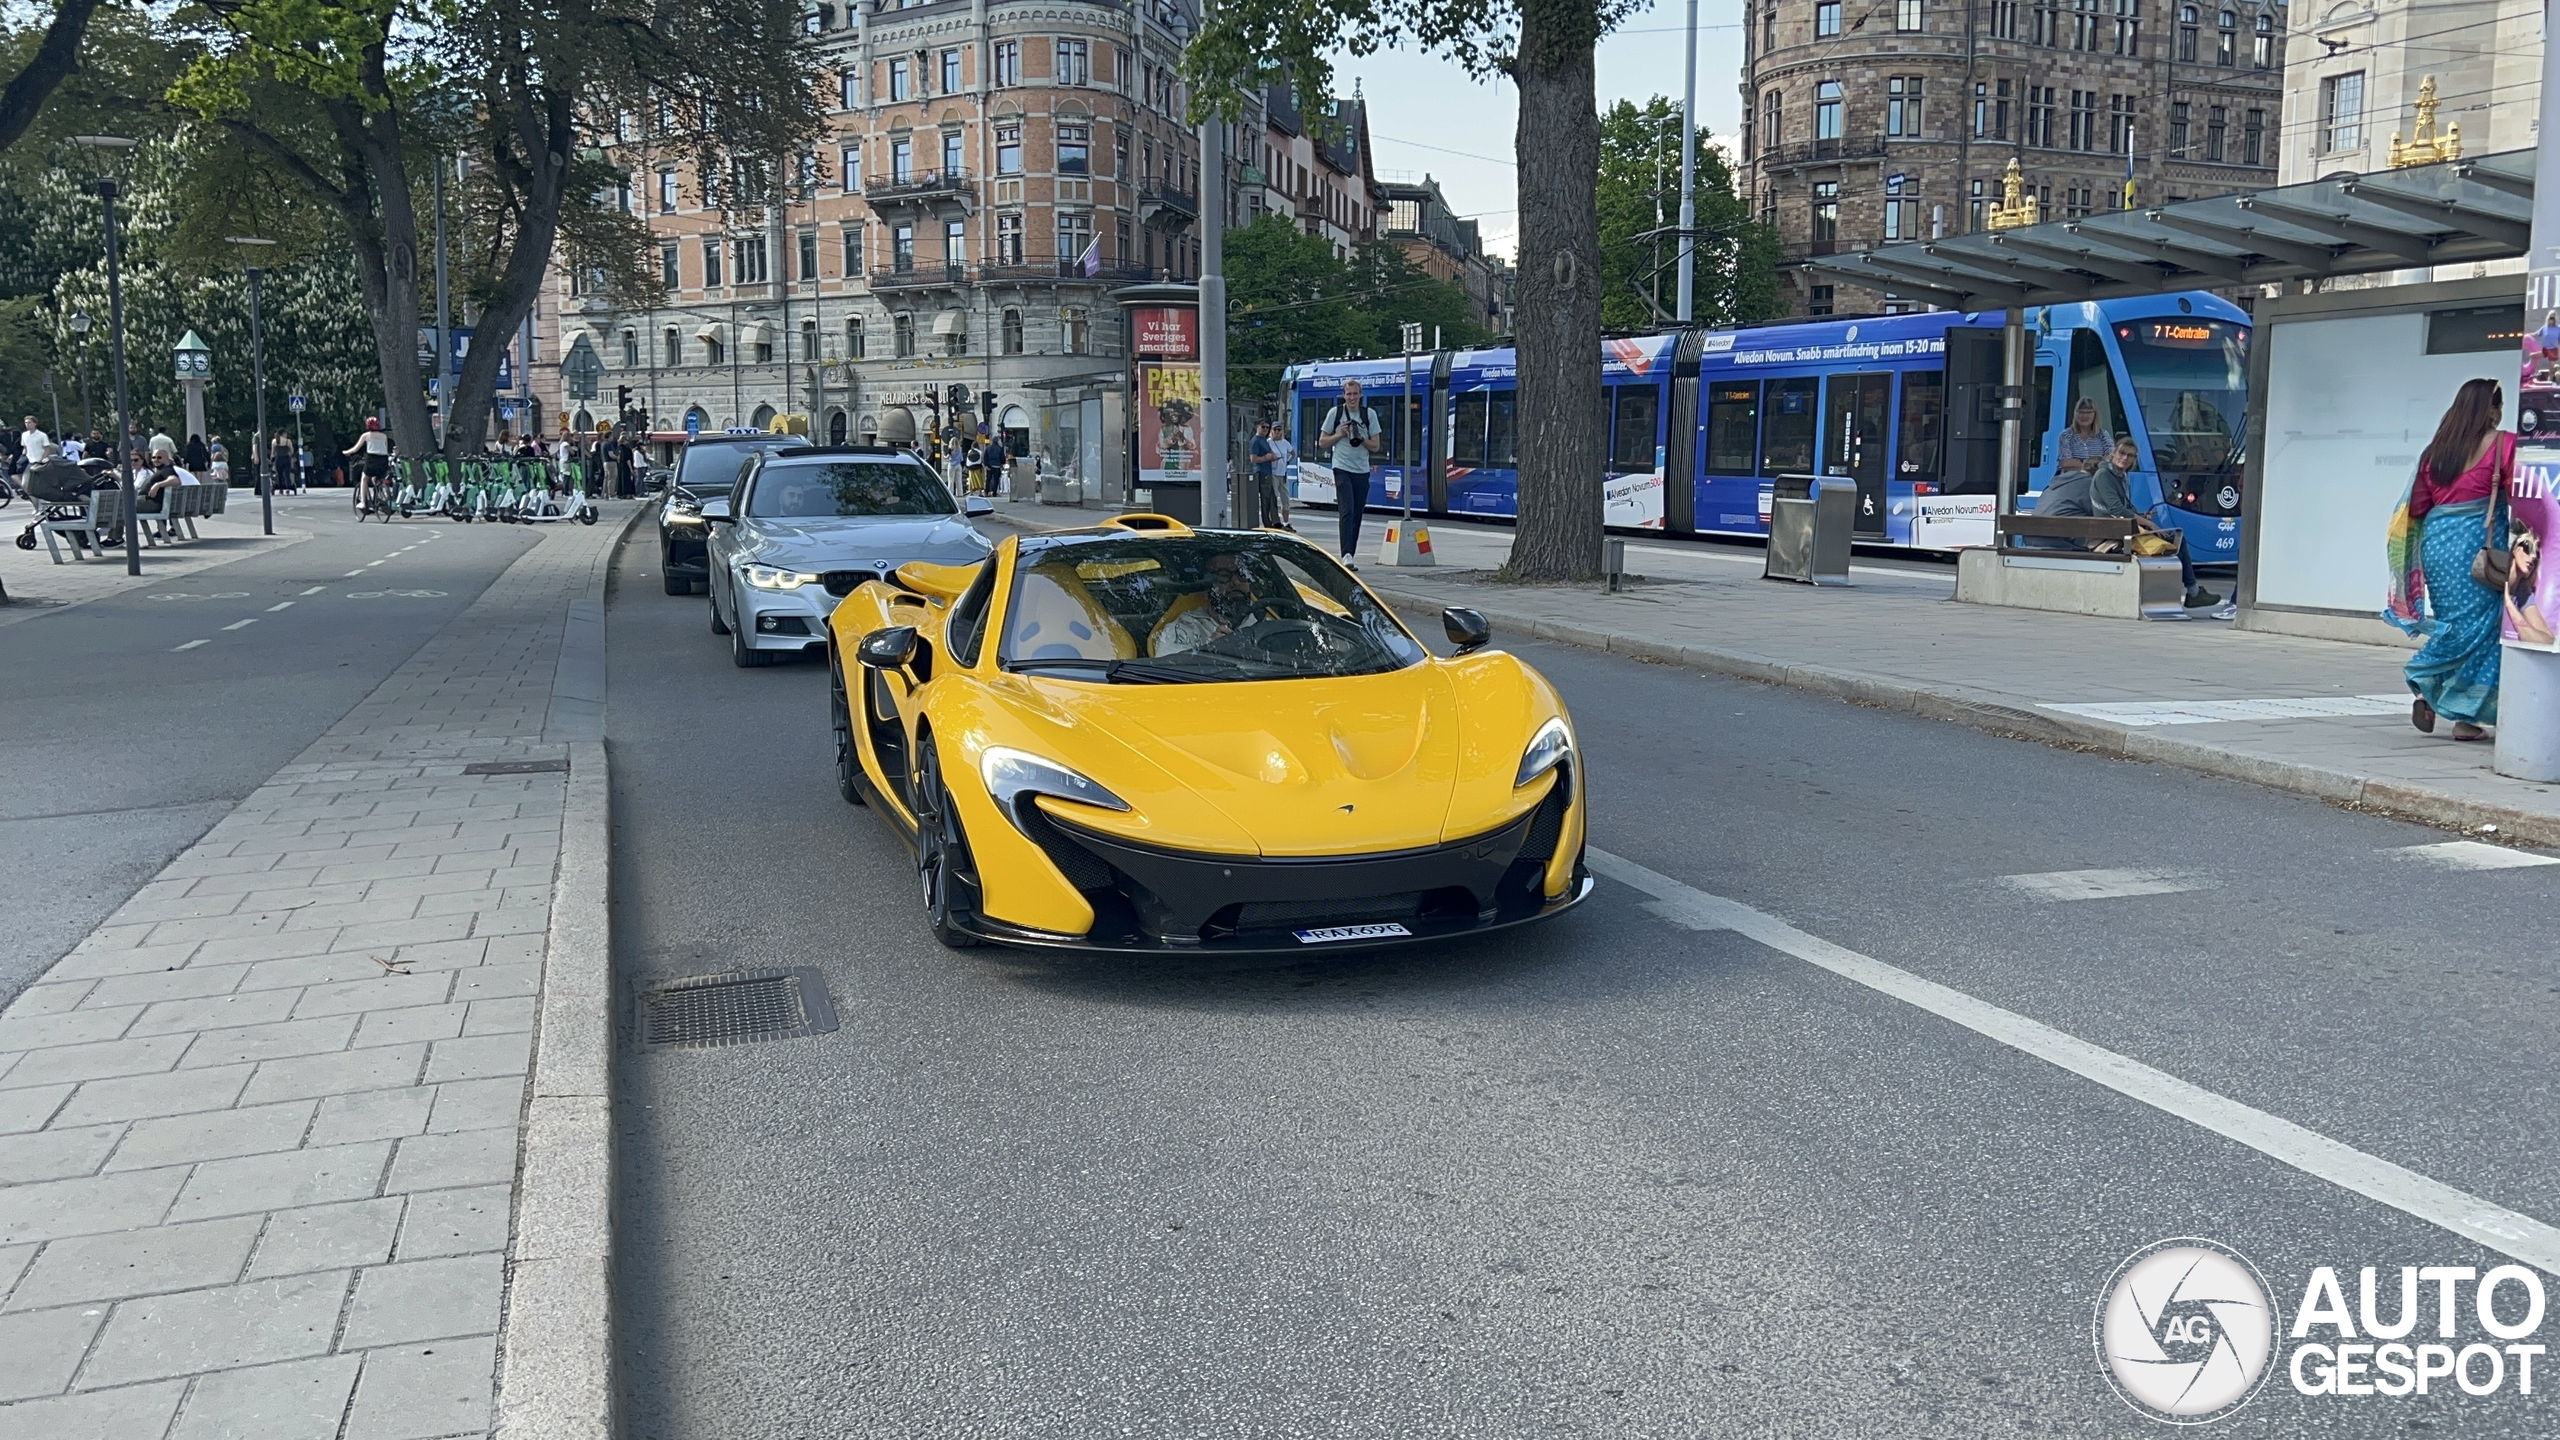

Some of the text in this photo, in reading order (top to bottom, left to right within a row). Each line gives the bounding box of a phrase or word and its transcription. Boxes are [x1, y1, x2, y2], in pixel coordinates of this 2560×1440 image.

[1147, 321, 1182, 331] Vi har
[1142, 332, 1186, 343] Sveriges
[2154, 325, 2210, 339] 7 T-Centralen
[1139, 343, 1190, 352] smartaste
[1710, 339, 1731, 348] Alvedon
[1734, 350, 1764, 364] Alvedon
[1765, 350, 1795, 363] Novum.
[1796, 346, 1822, 361] Snabb
[1822, 343, 1879, 360] smärtlindring
[1880, 342, 1904, 355] inom
[1905, 339, 1928, 353] 15-20
[1480, 367, 1501, 379] Alvedon
[1147, 368, 1200, 391] PARK
[1611, 486, 1632, 499] Alvedon
[2223, 489, 2233, 499] SL
[1927, 505, 1954, 516] Alvedon
[2215, 537, 2235, 549] 469
